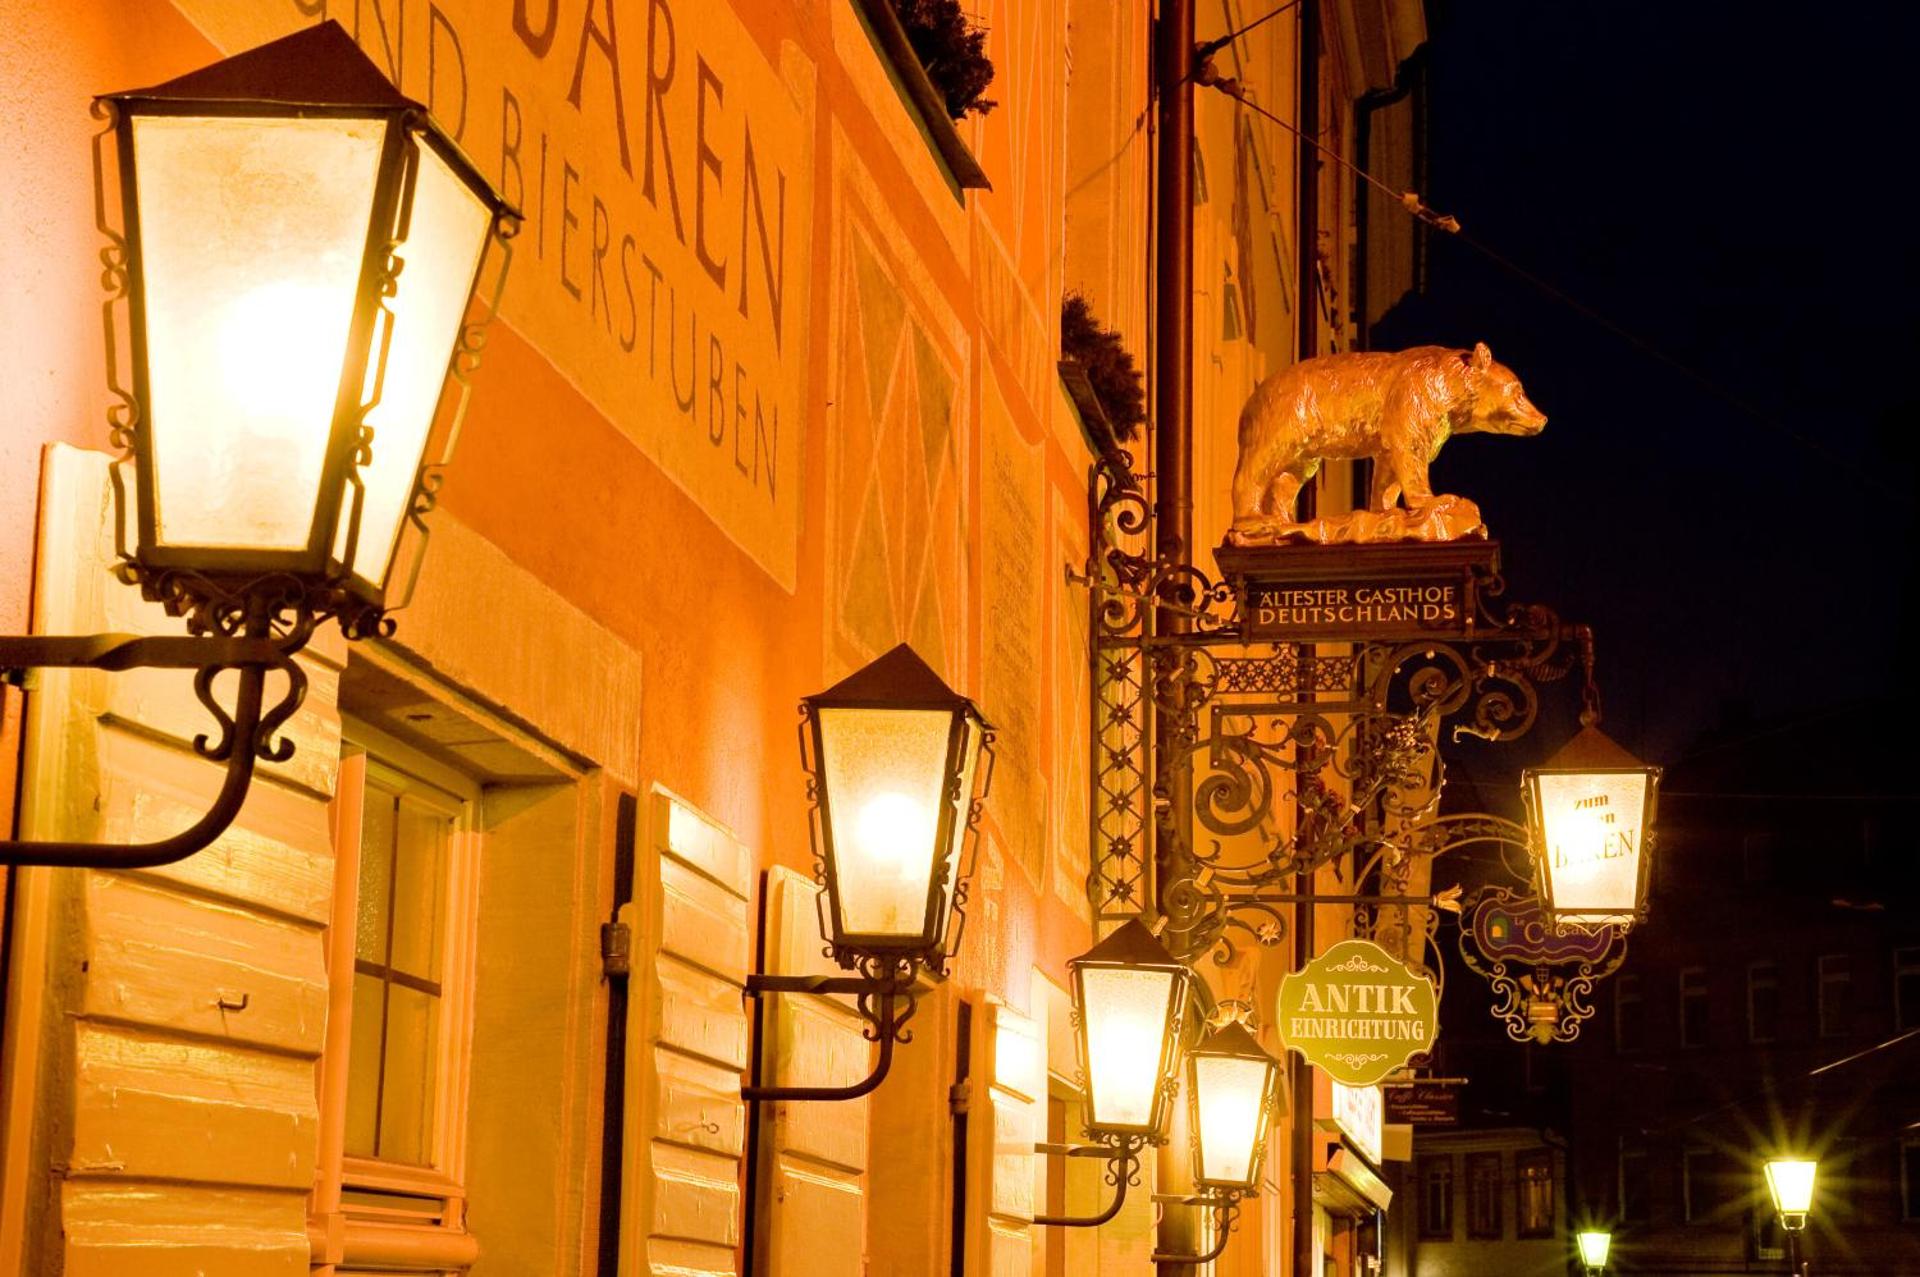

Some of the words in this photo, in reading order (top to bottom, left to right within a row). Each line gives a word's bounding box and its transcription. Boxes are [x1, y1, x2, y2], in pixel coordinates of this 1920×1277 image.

[502, 86, 778, 504] BIERSTUBEN
[1260, 590, 1349, 607] ÄLTESTER
[1354, 586, 1455, 604] GASTHOF
[1259, 603, 1455, 625] DEUTSCHLANDS
[1299, 983, 1417, 1014] ANTIK
[1290, 1017, 1425, 1042] EINRICHTUNG
